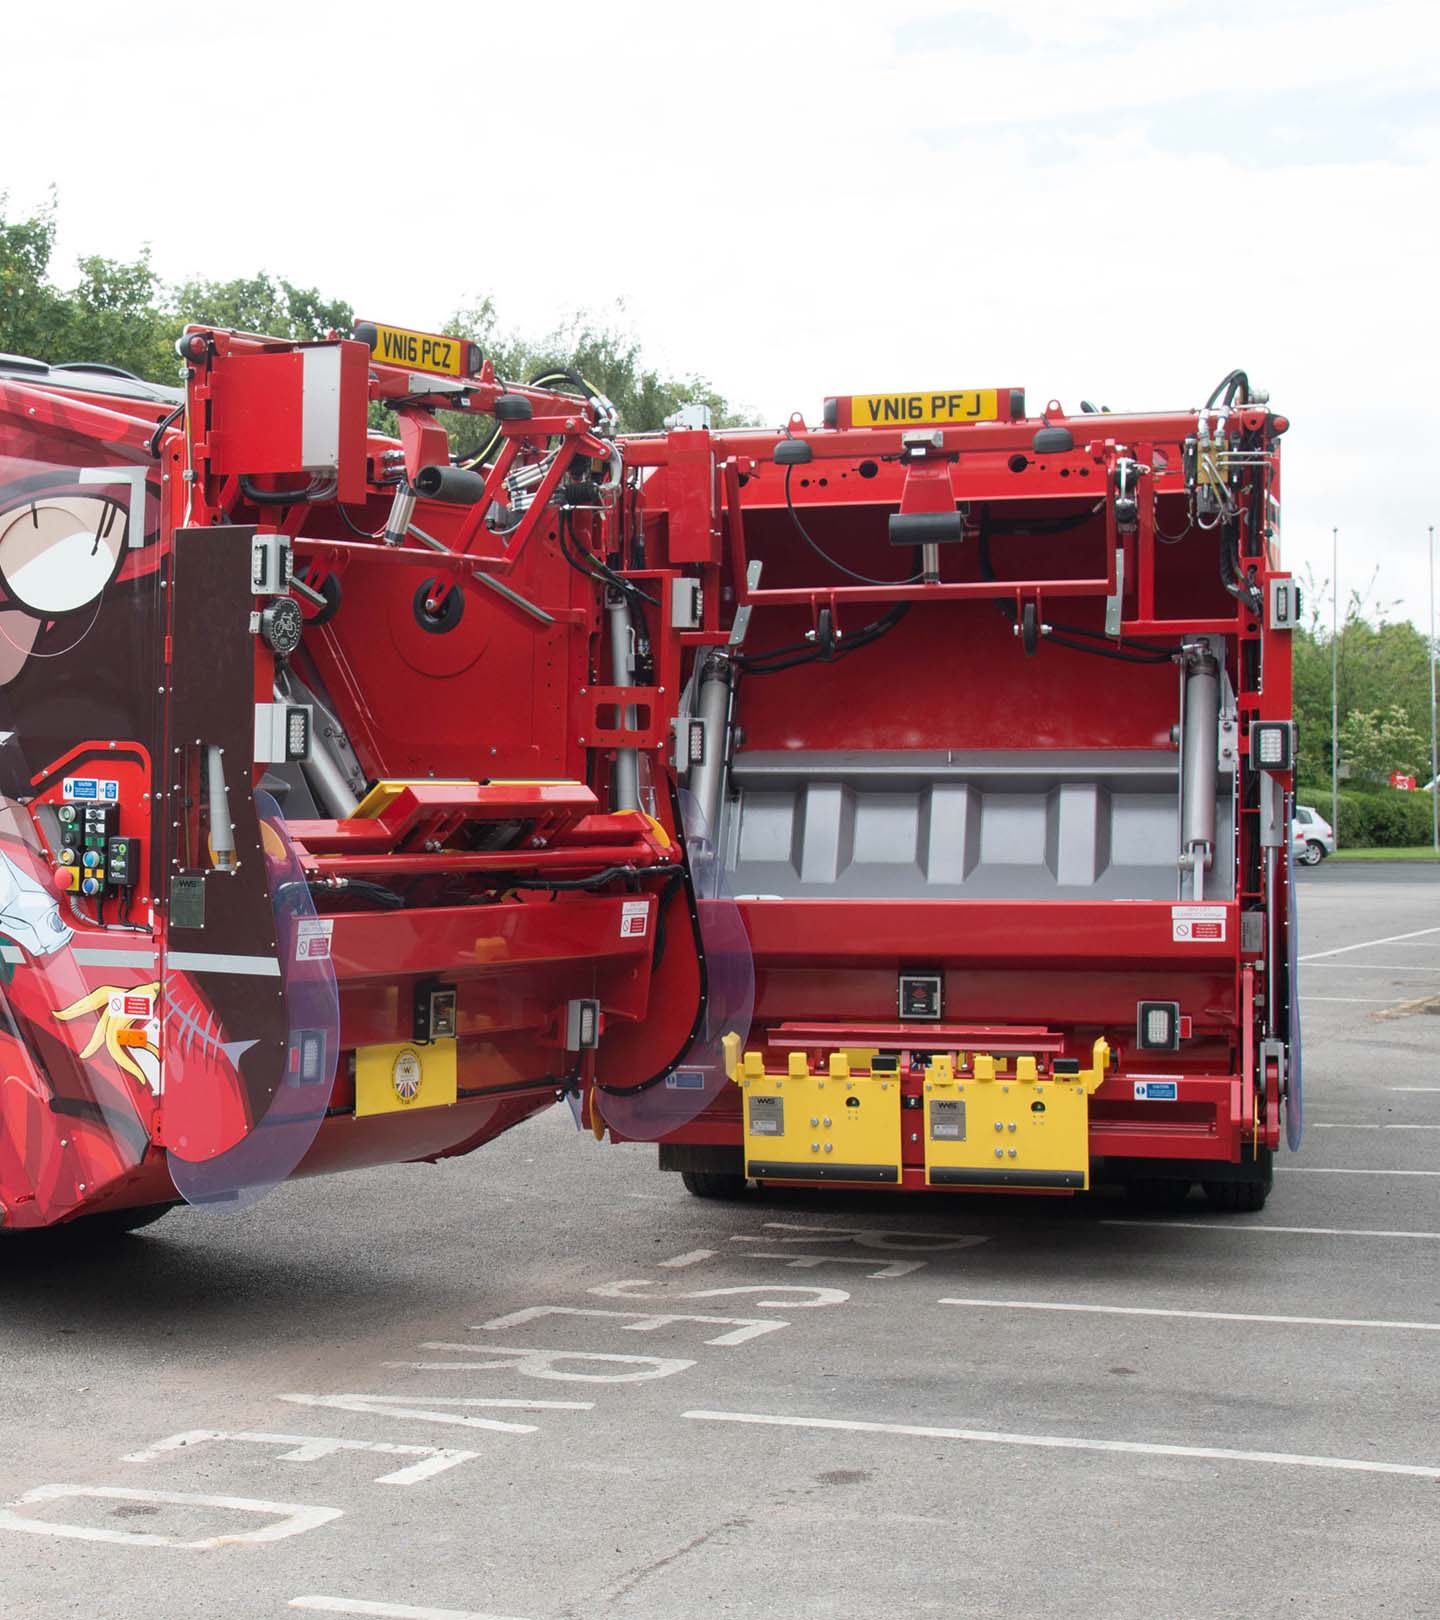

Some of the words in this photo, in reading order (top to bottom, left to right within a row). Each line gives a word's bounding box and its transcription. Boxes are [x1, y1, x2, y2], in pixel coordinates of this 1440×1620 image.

[383, 331, 417, 362] VN16
[422, 339, 451, 368] PCZ
[868, 397, 923, 421] VN16
[931, 394, 981, 418] PFJ
